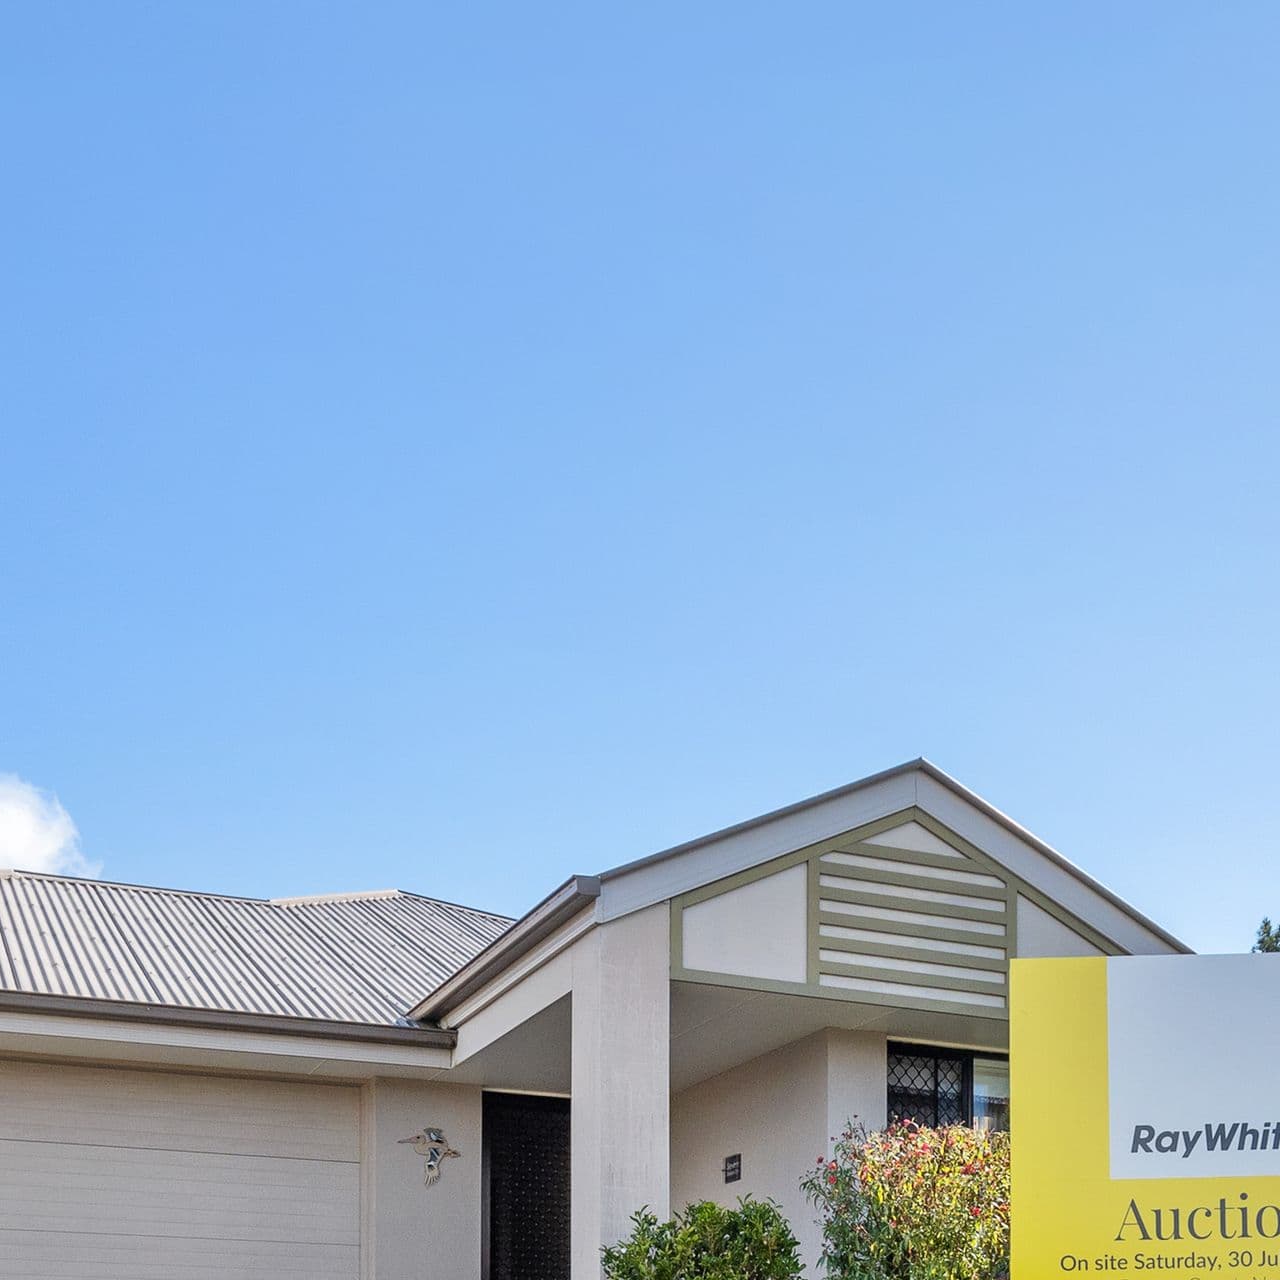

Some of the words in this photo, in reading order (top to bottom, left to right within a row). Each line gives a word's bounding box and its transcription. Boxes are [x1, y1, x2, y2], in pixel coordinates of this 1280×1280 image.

[1060, 1254, 1088, 1272] On
[1095, 1254, 1128, 1271] site
[1134, 1251, 1222, 1271] Saturday,
[1228, 1250, 1253, 1268] 30
